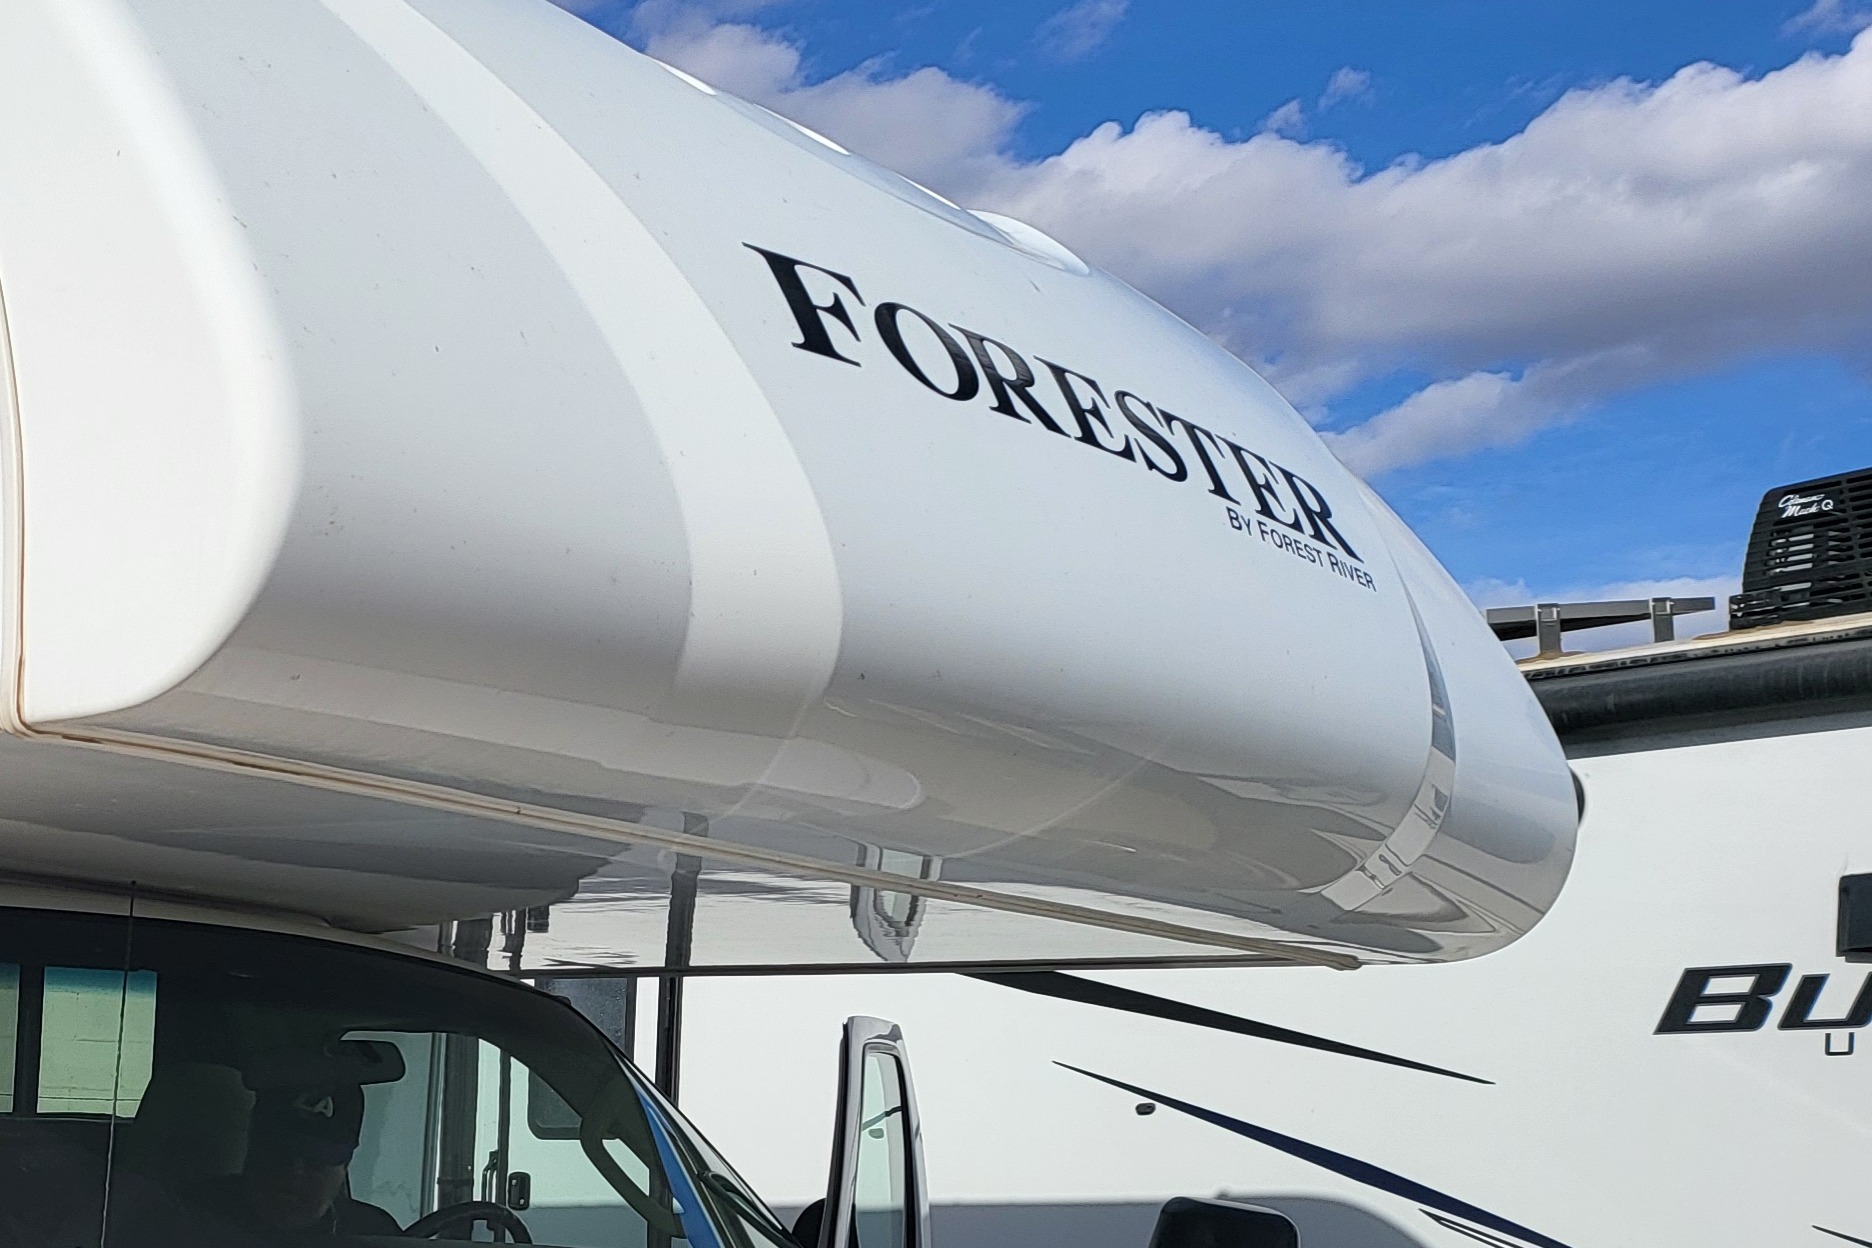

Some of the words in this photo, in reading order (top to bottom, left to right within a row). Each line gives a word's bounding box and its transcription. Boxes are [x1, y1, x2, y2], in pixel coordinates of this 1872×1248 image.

[741, 240, 1365, 563] FORESTER
[1257, 520, 1324, 567] FOREST
[1327, 551, 1377, 592] RIVER
